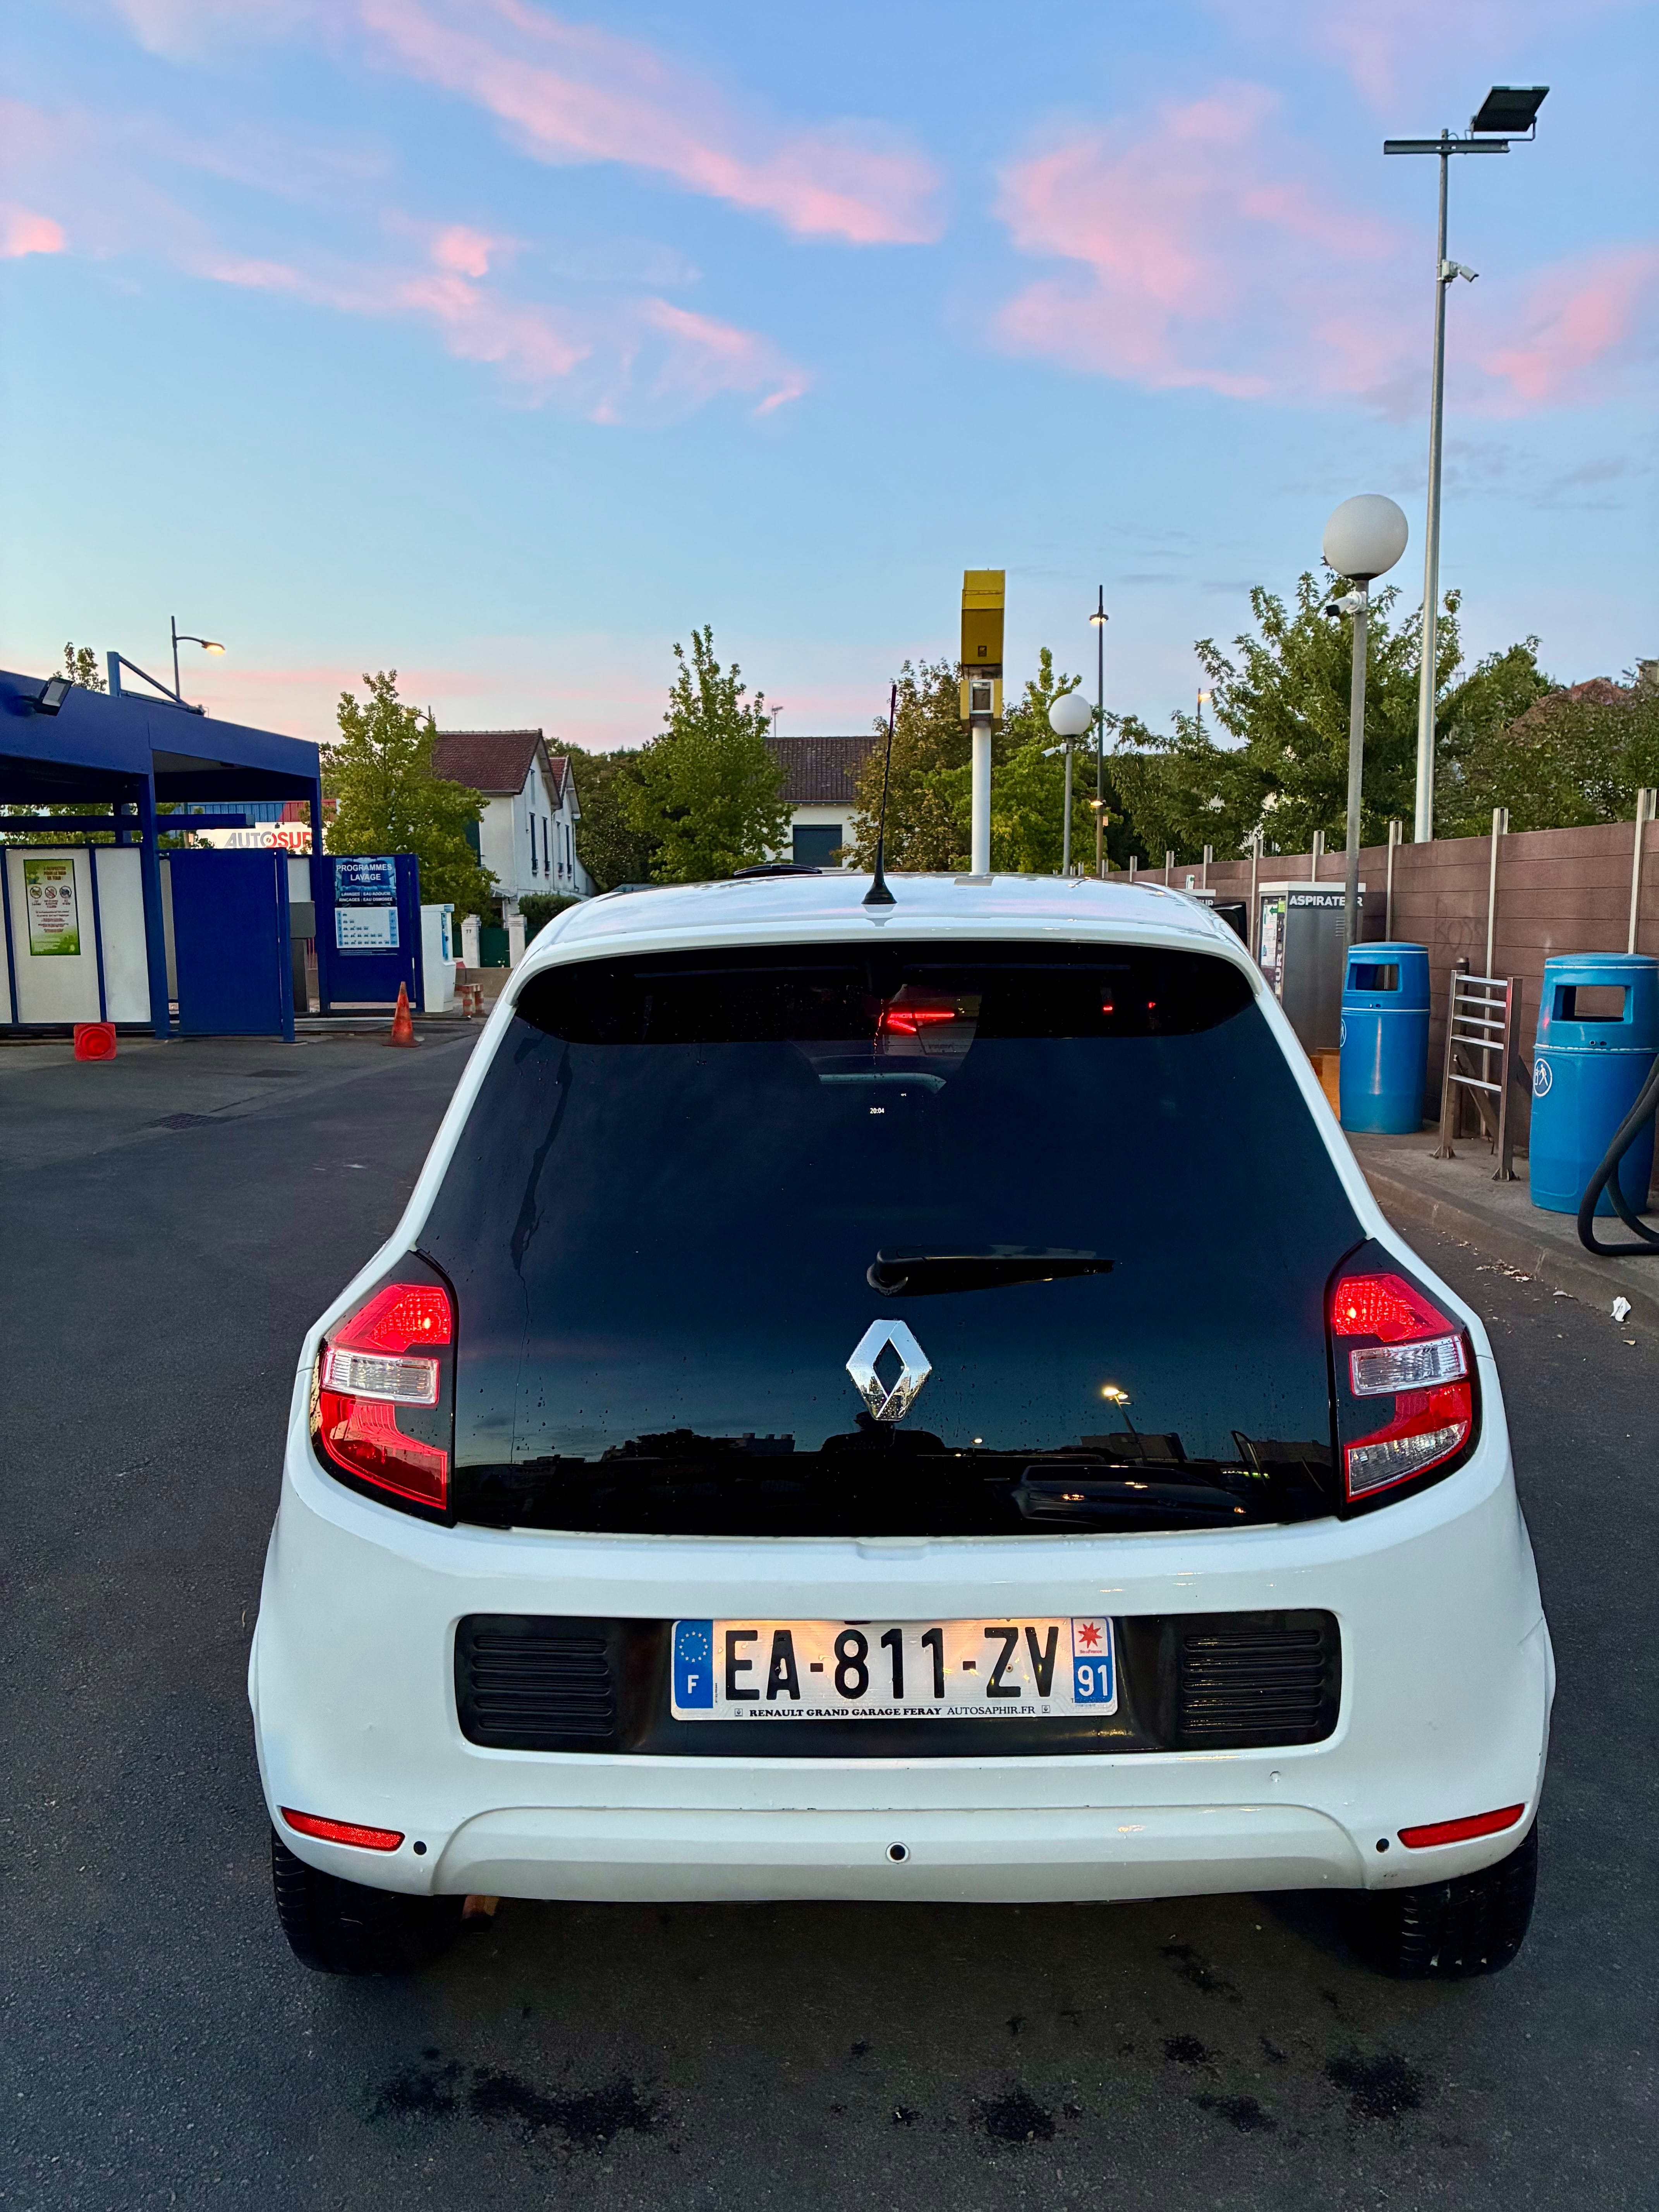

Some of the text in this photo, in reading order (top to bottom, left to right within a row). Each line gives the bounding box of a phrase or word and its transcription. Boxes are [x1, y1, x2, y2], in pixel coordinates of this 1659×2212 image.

[336, 864, 392, 872] PROGRAMMES
[1289, 895, 1363, 907] ASPIRATER
[726, 1627, 1059, 1700] EA-811-ZV
[688, 1675, 699, 1693] F
[1078, 1665, 1108, 1697] 91
[947, 1706, 1035, 1715] AUTOSAPHIR.FR
